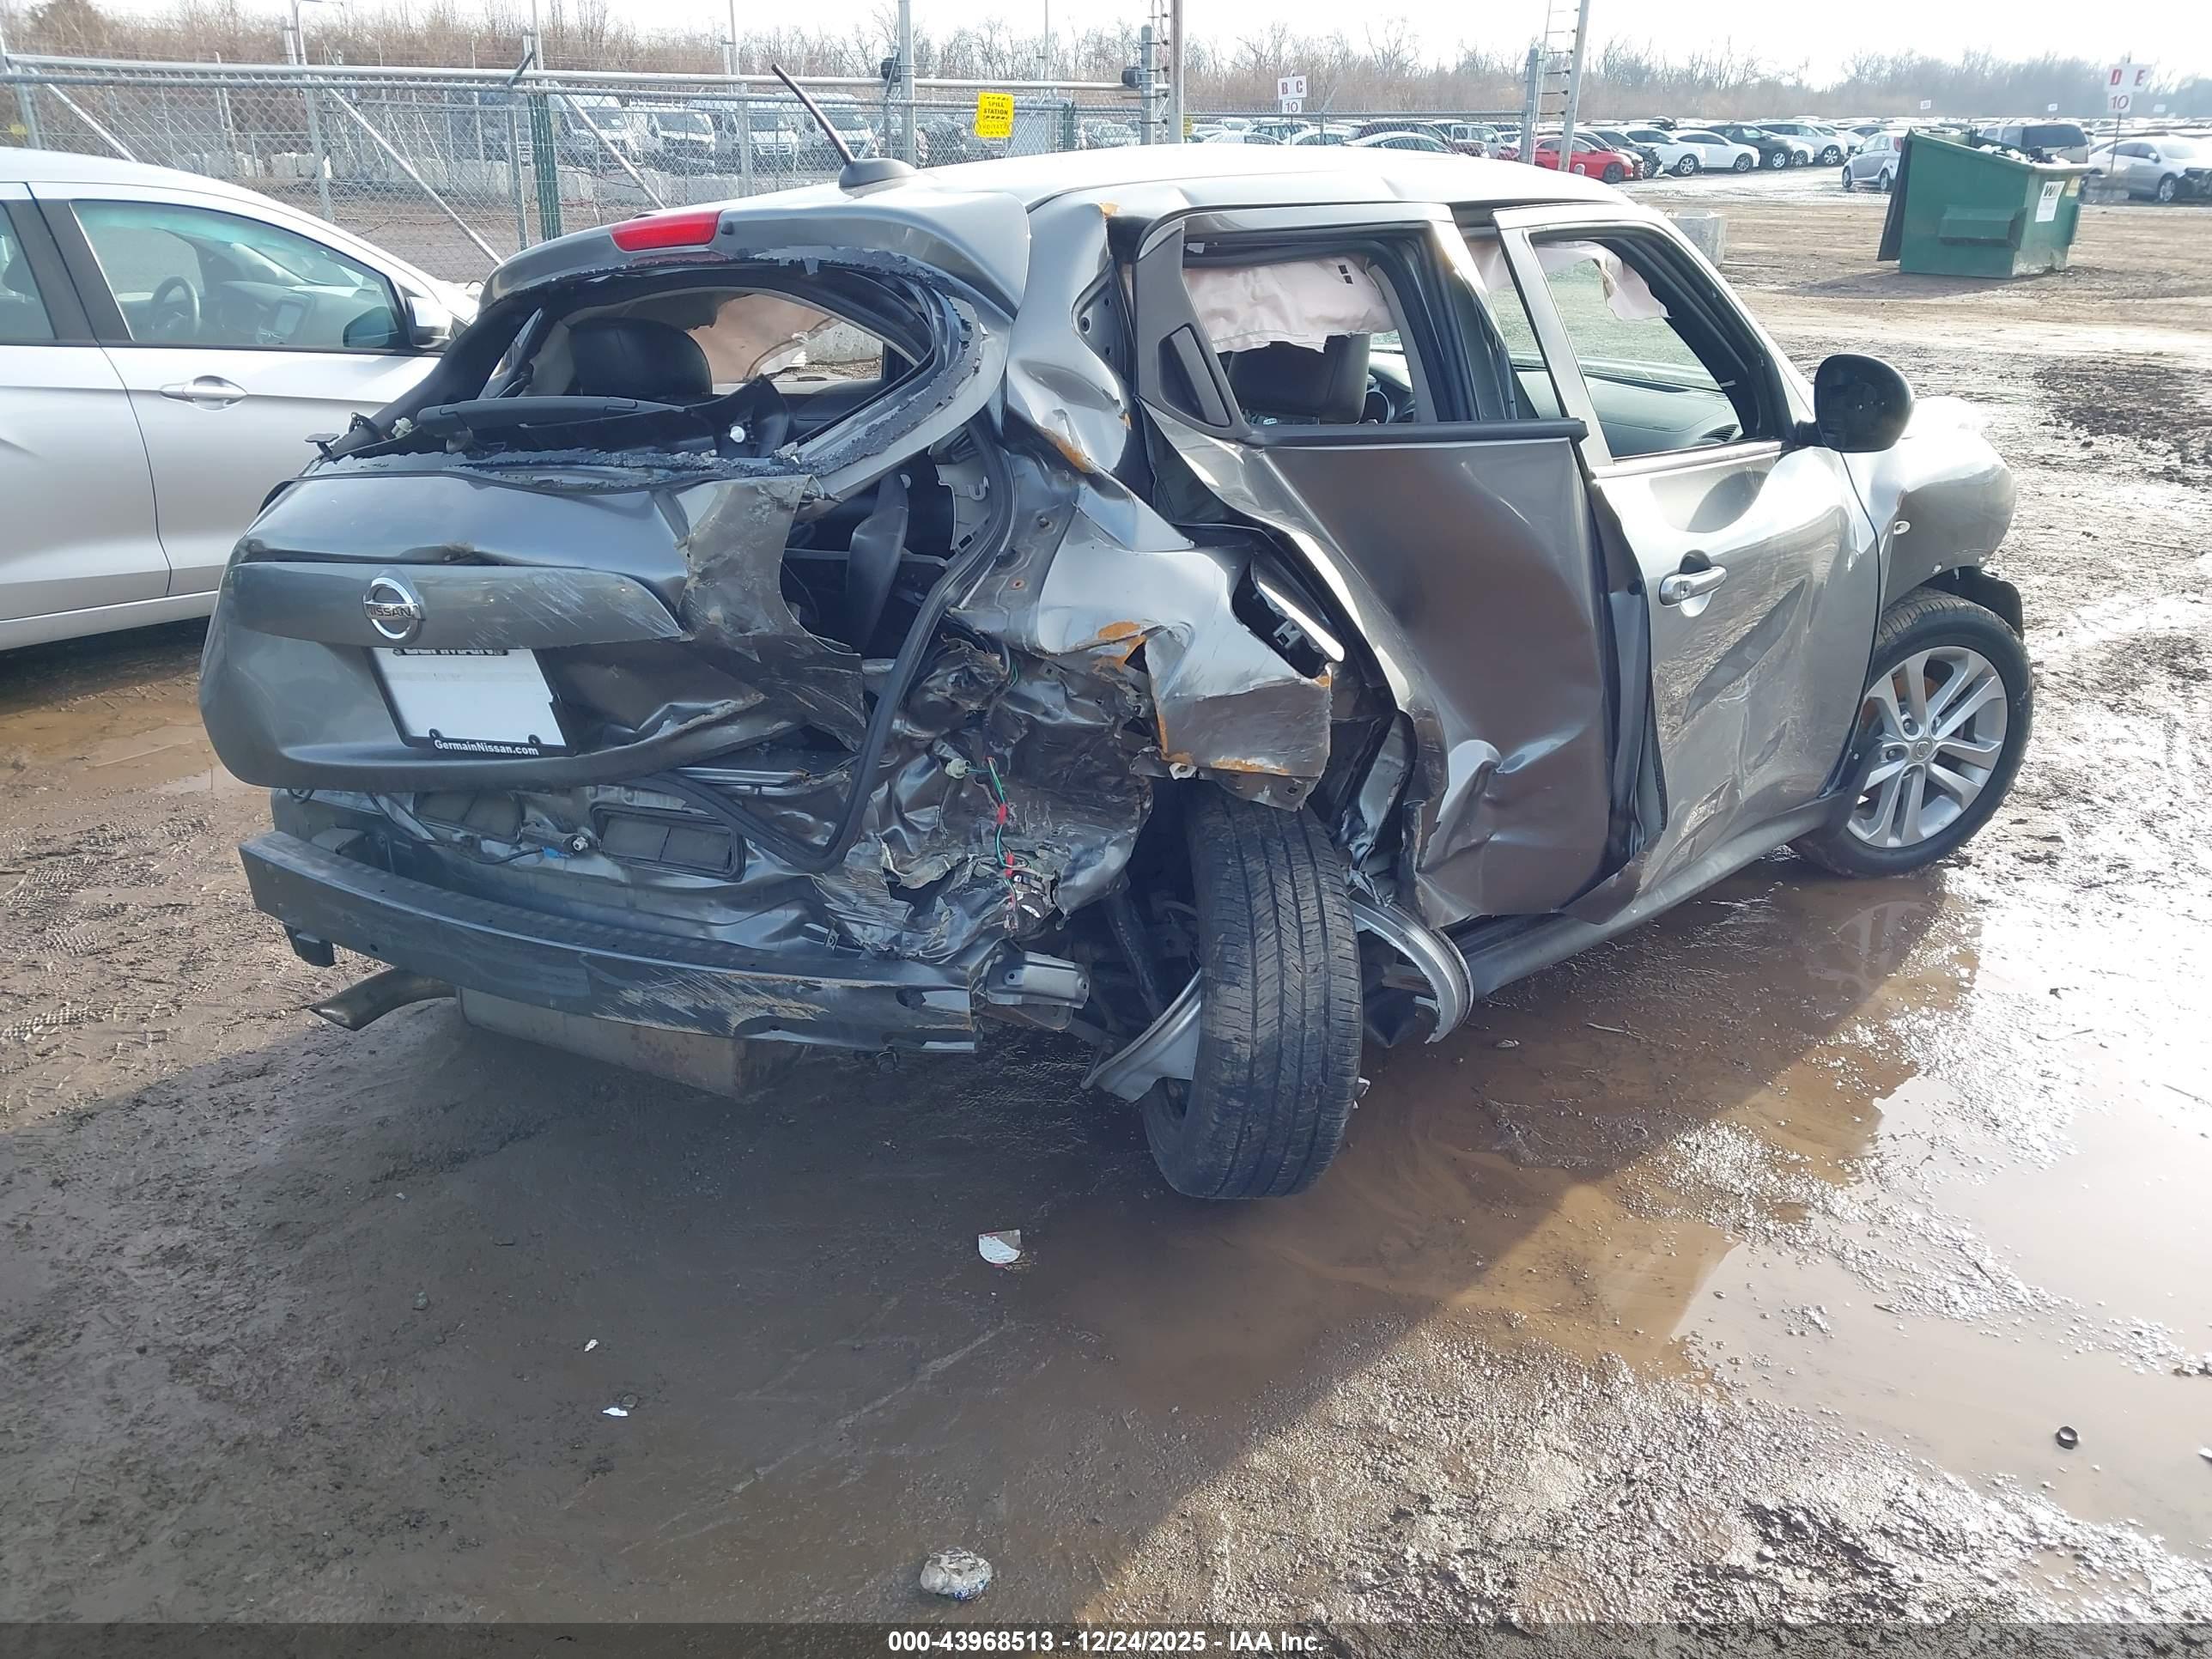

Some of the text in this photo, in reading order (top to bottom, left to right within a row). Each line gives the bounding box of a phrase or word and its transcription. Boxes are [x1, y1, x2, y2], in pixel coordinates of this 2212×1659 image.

[2110, 69, 2146, 86] D E
[1281, 80, 1303, 94] B C
[1285, 101, 1298, 112] 10
[2111, 95, 2130, 109] 10
[370, 606, 411, 617] NISSAN
[434, 739, 539, 756] GermainNissan.com
